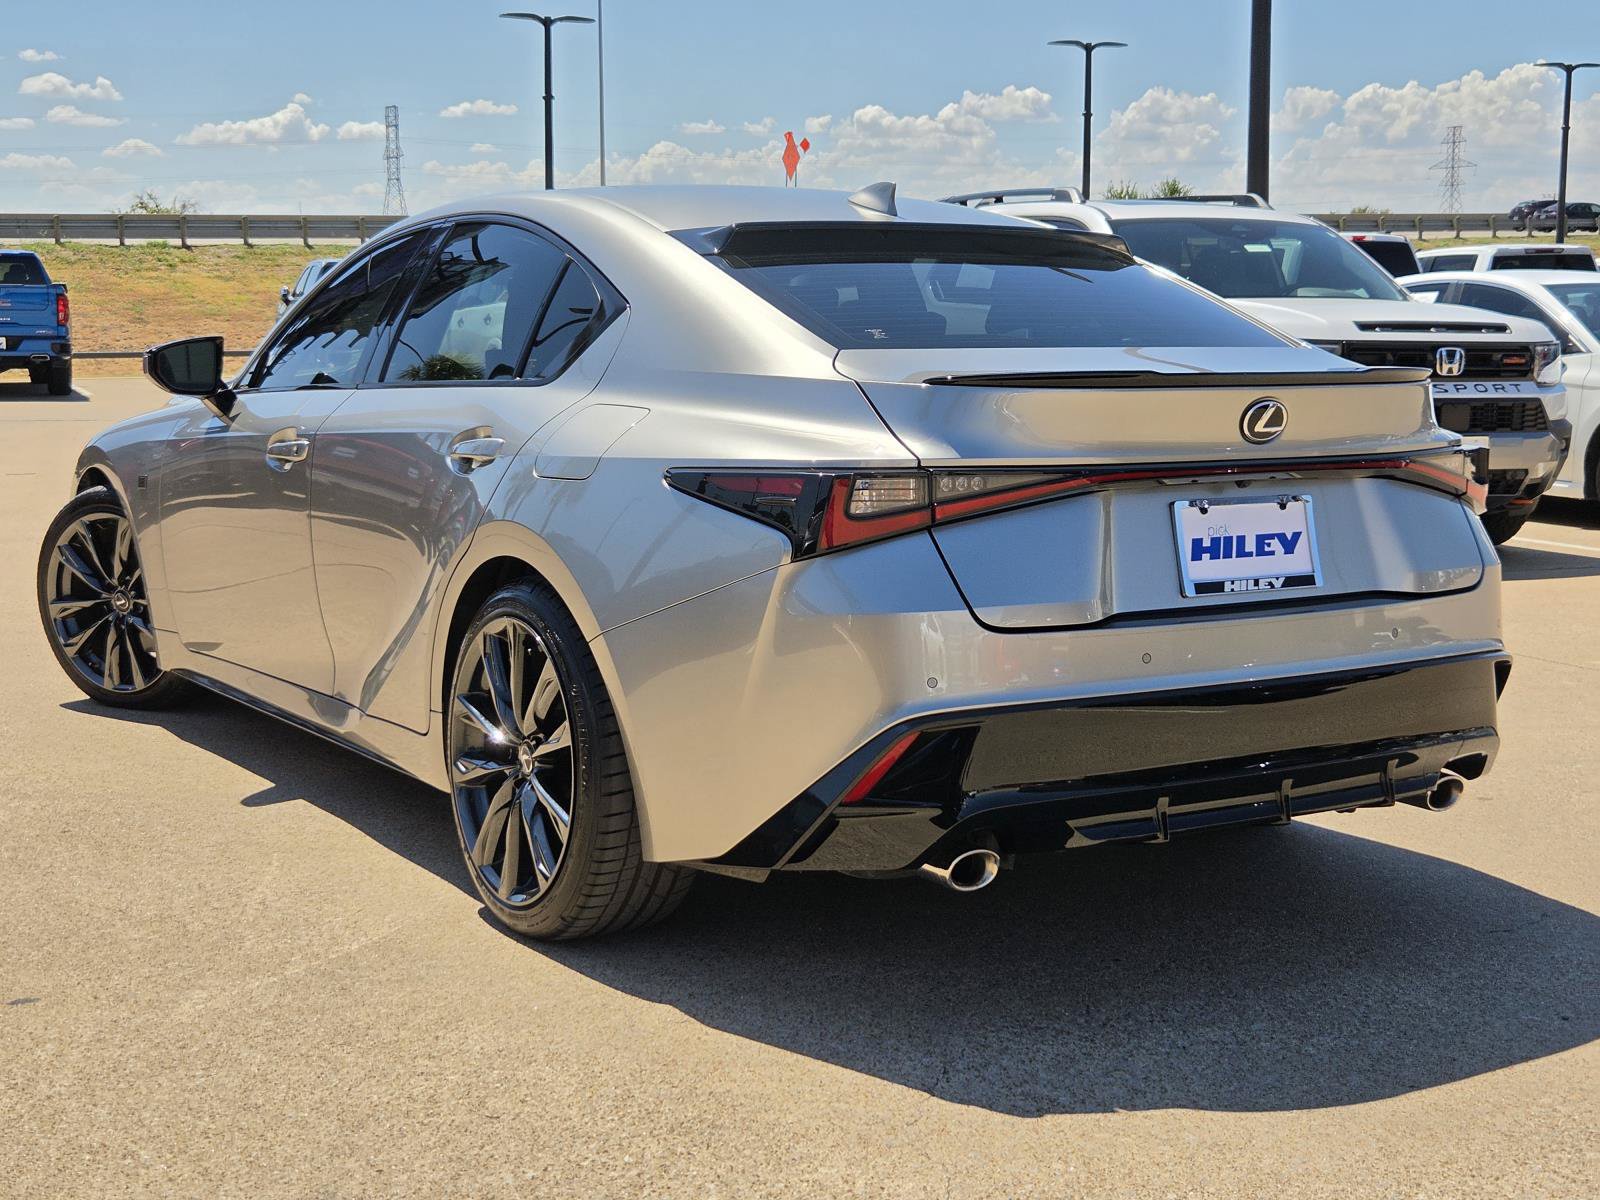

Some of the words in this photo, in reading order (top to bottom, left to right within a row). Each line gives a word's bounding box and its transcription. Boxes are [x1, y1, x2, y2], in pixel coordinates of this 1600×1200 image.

[1207, 523, 1231, 539] pick
[1190, 531, 1302, 562] HILEY
[1223, 577, 1286, 592] HILEY
